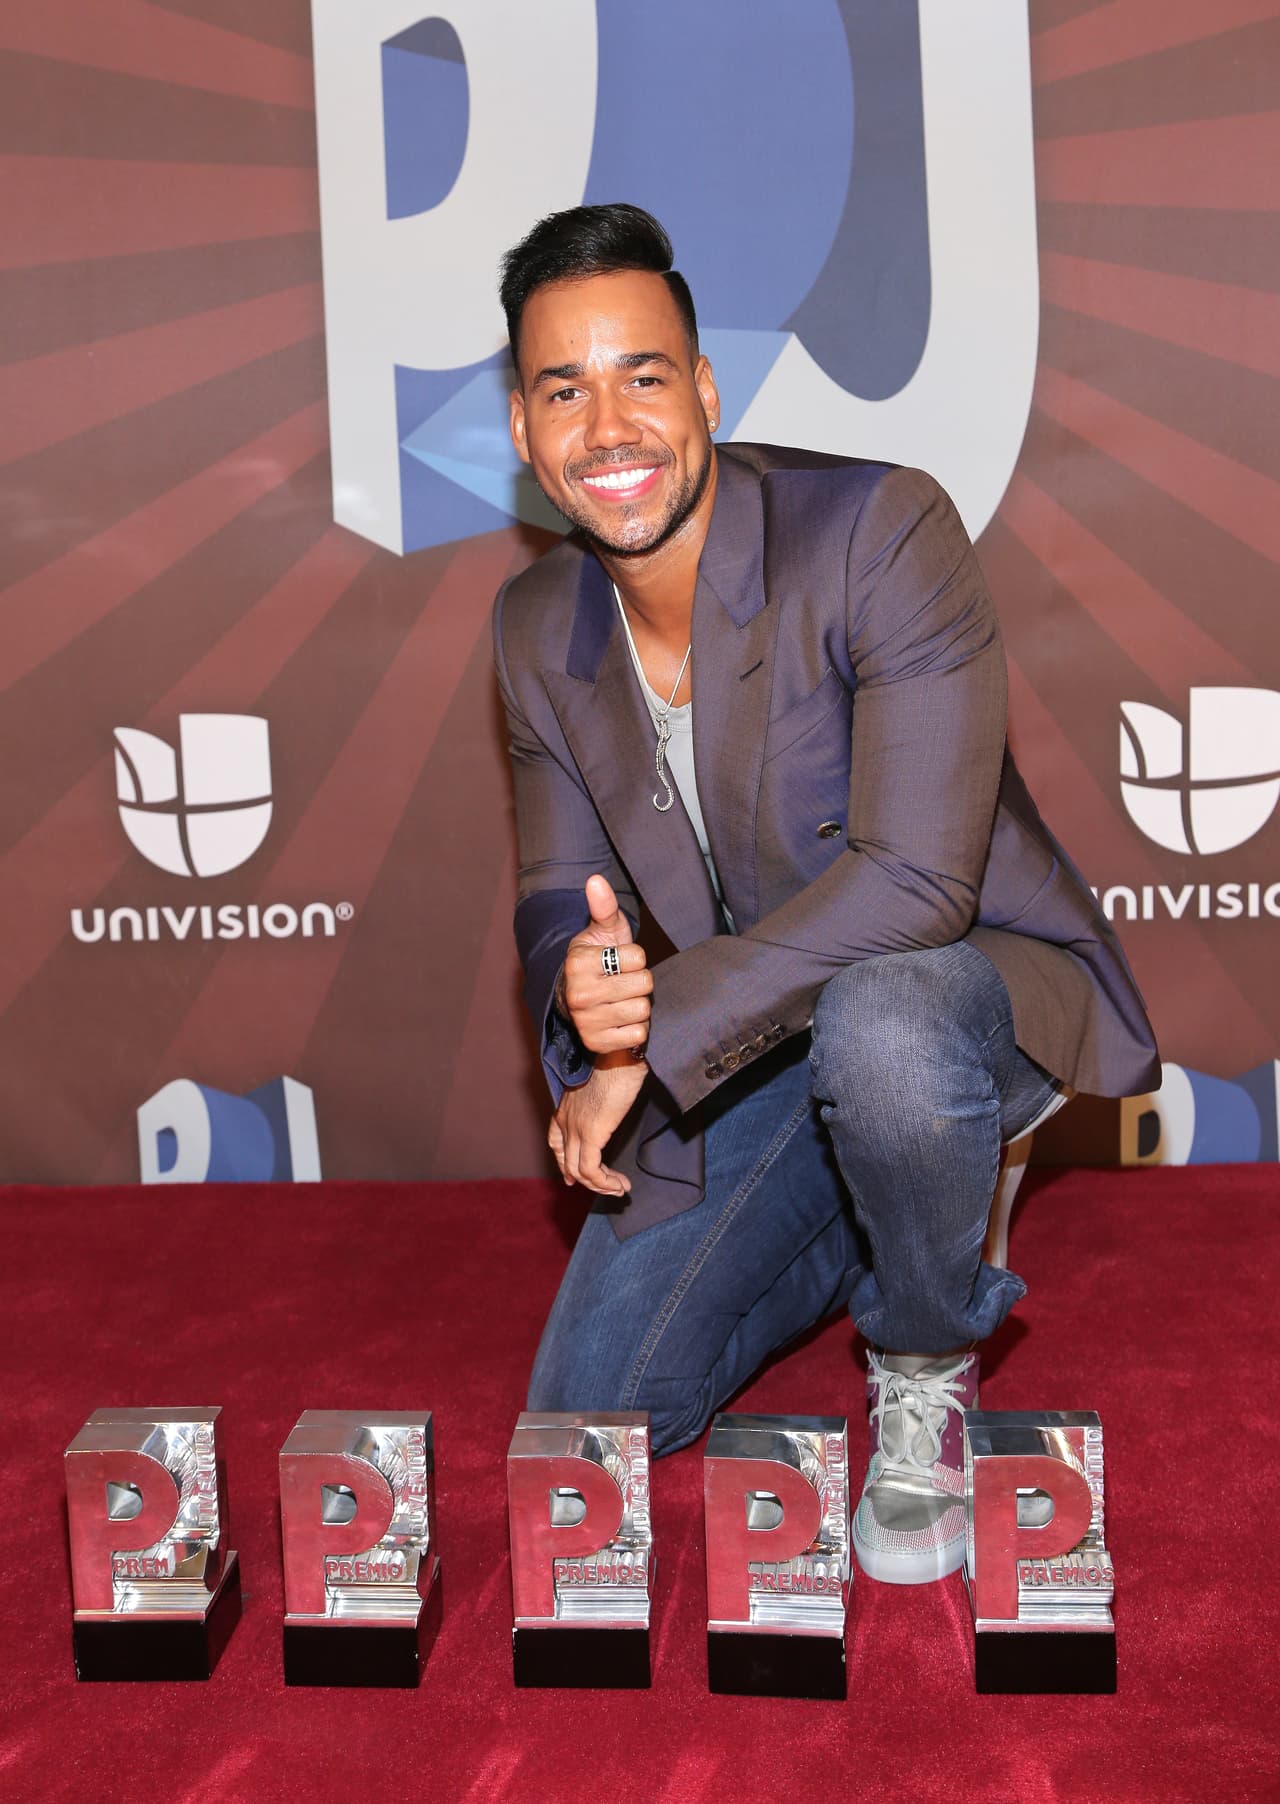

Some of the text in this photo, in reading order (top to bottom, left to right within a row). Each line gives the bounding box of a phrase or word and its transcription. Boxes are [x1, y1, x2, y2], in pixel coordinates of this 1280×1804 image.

[1090, 882, 1280, 920] NIVISI
[113, 1557, 169, 1575] PREM
[325, 1560, 403, 1579] PREMIO
[554, 1563, 647, 1582] PREMIOS
[1020, 1565, 1115, 1583] PREMIOS
[748, 1572, 842, 1592] PREMIOS
